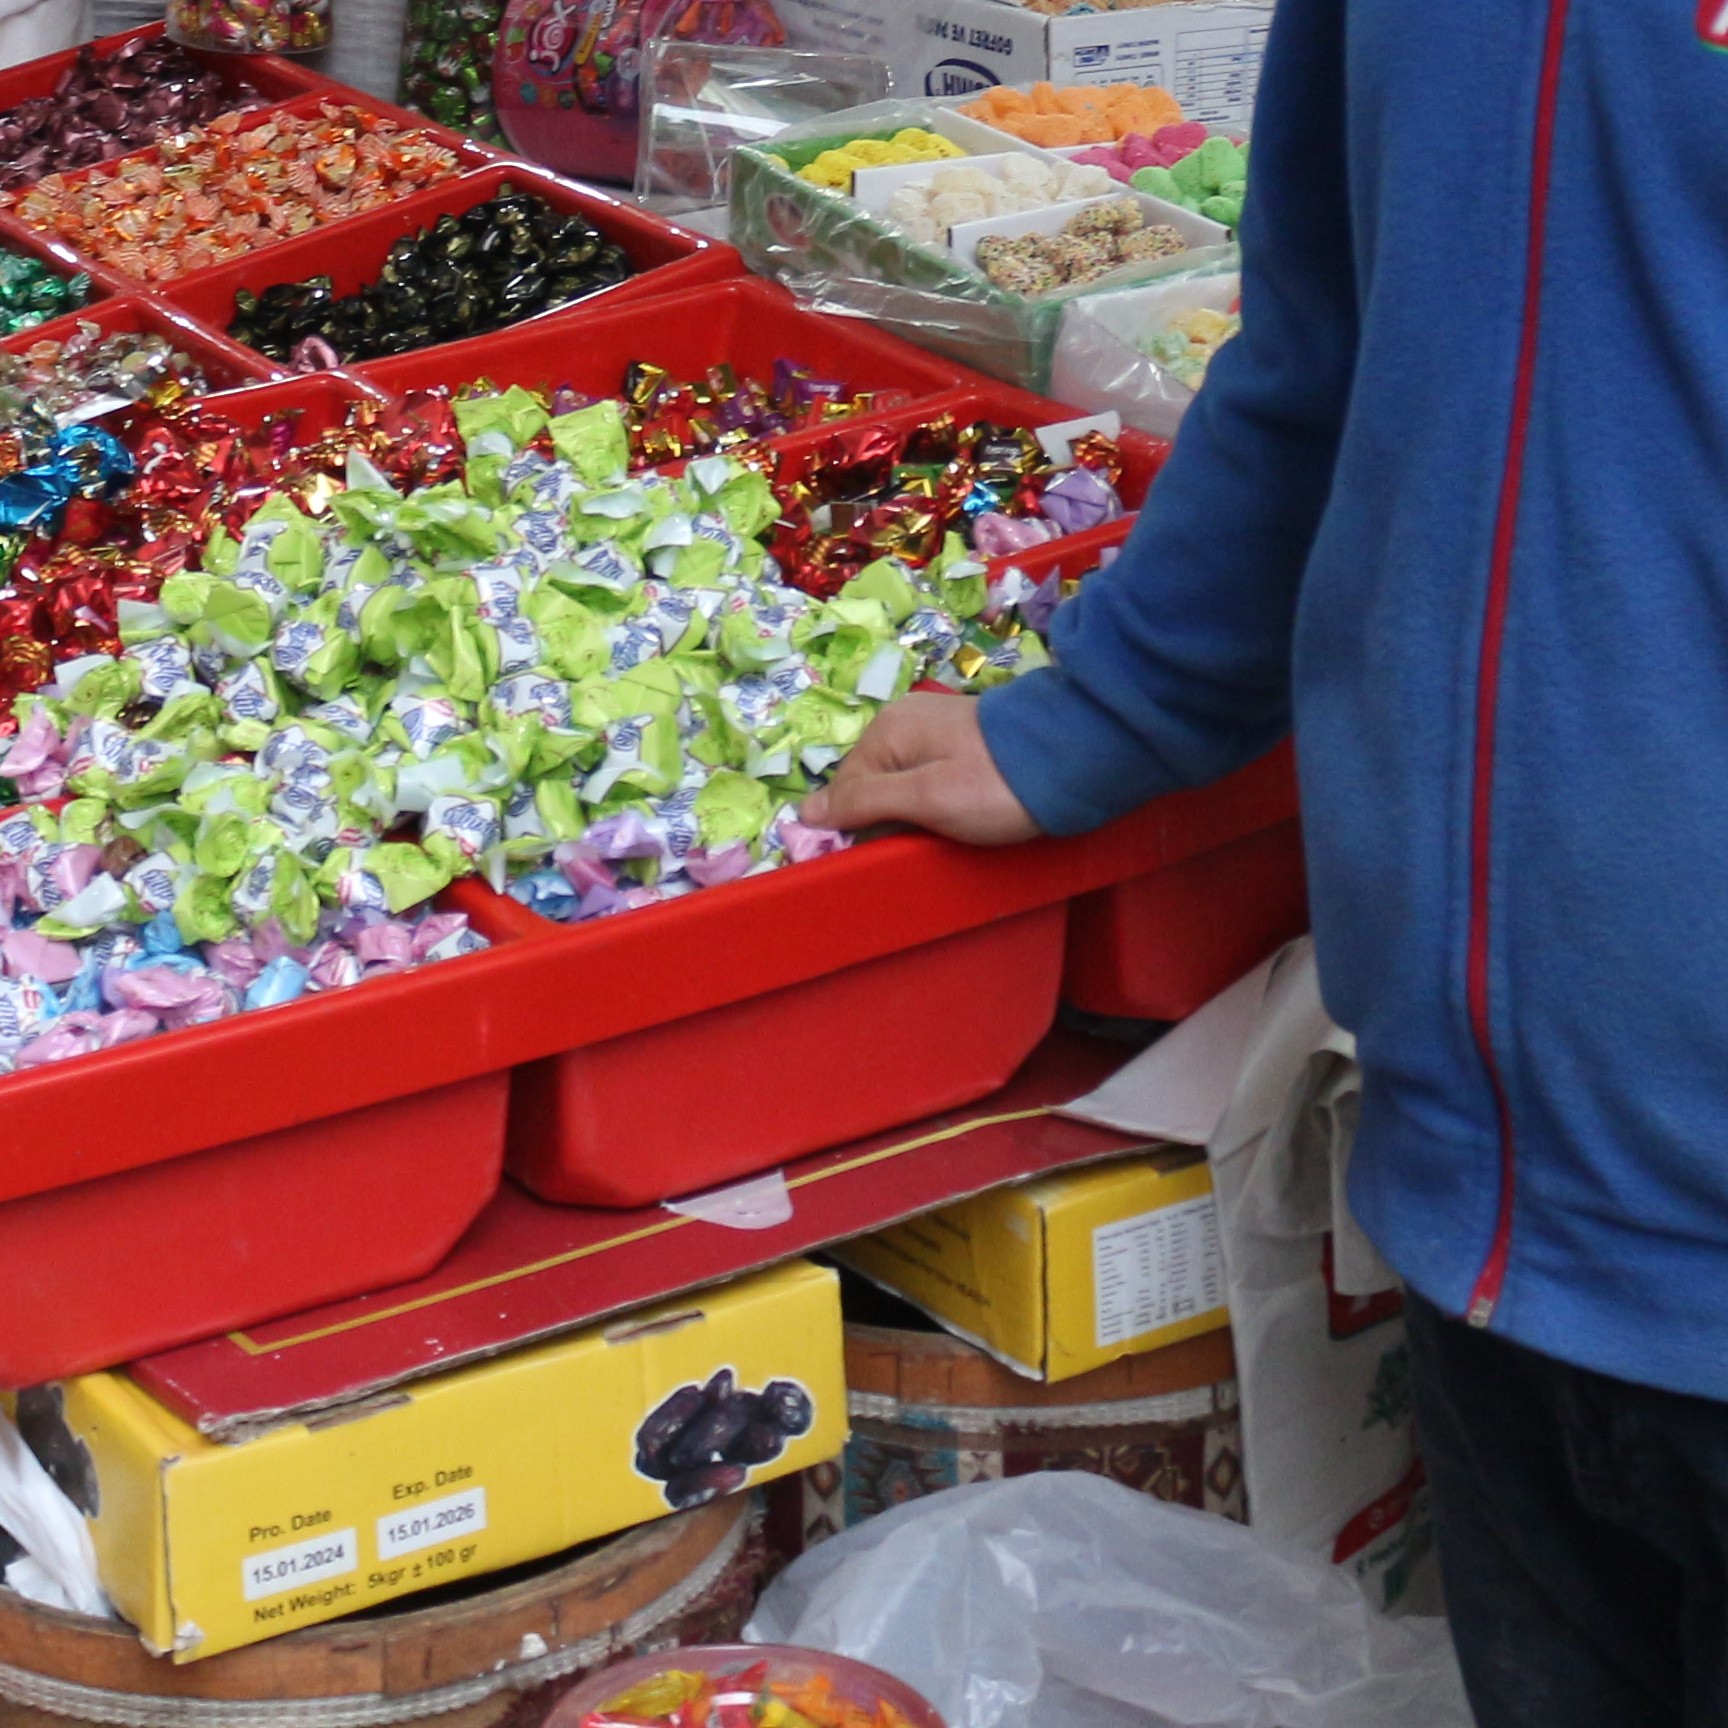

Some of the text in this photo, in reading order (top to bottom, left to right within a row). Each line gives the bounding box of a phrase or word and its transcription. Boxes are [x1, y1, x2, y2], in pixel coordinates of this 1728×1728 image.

[967, 28, 1015, 58] GOFRET
[392, 1465, 474, 1500] Exp. Date
[249, 1508, 333, 1542] Pro. Date
[387, 1502, 476, 1544] 15.01.2026
[251, 1544, 346, 1585] 15.01.2024
[252, 1603, 285, 1623] Net
[288, 1581, 356, 1614] Weight:
[425, 1548, 455, 1570] 100
[458, 1543, 478, 1563] gr
